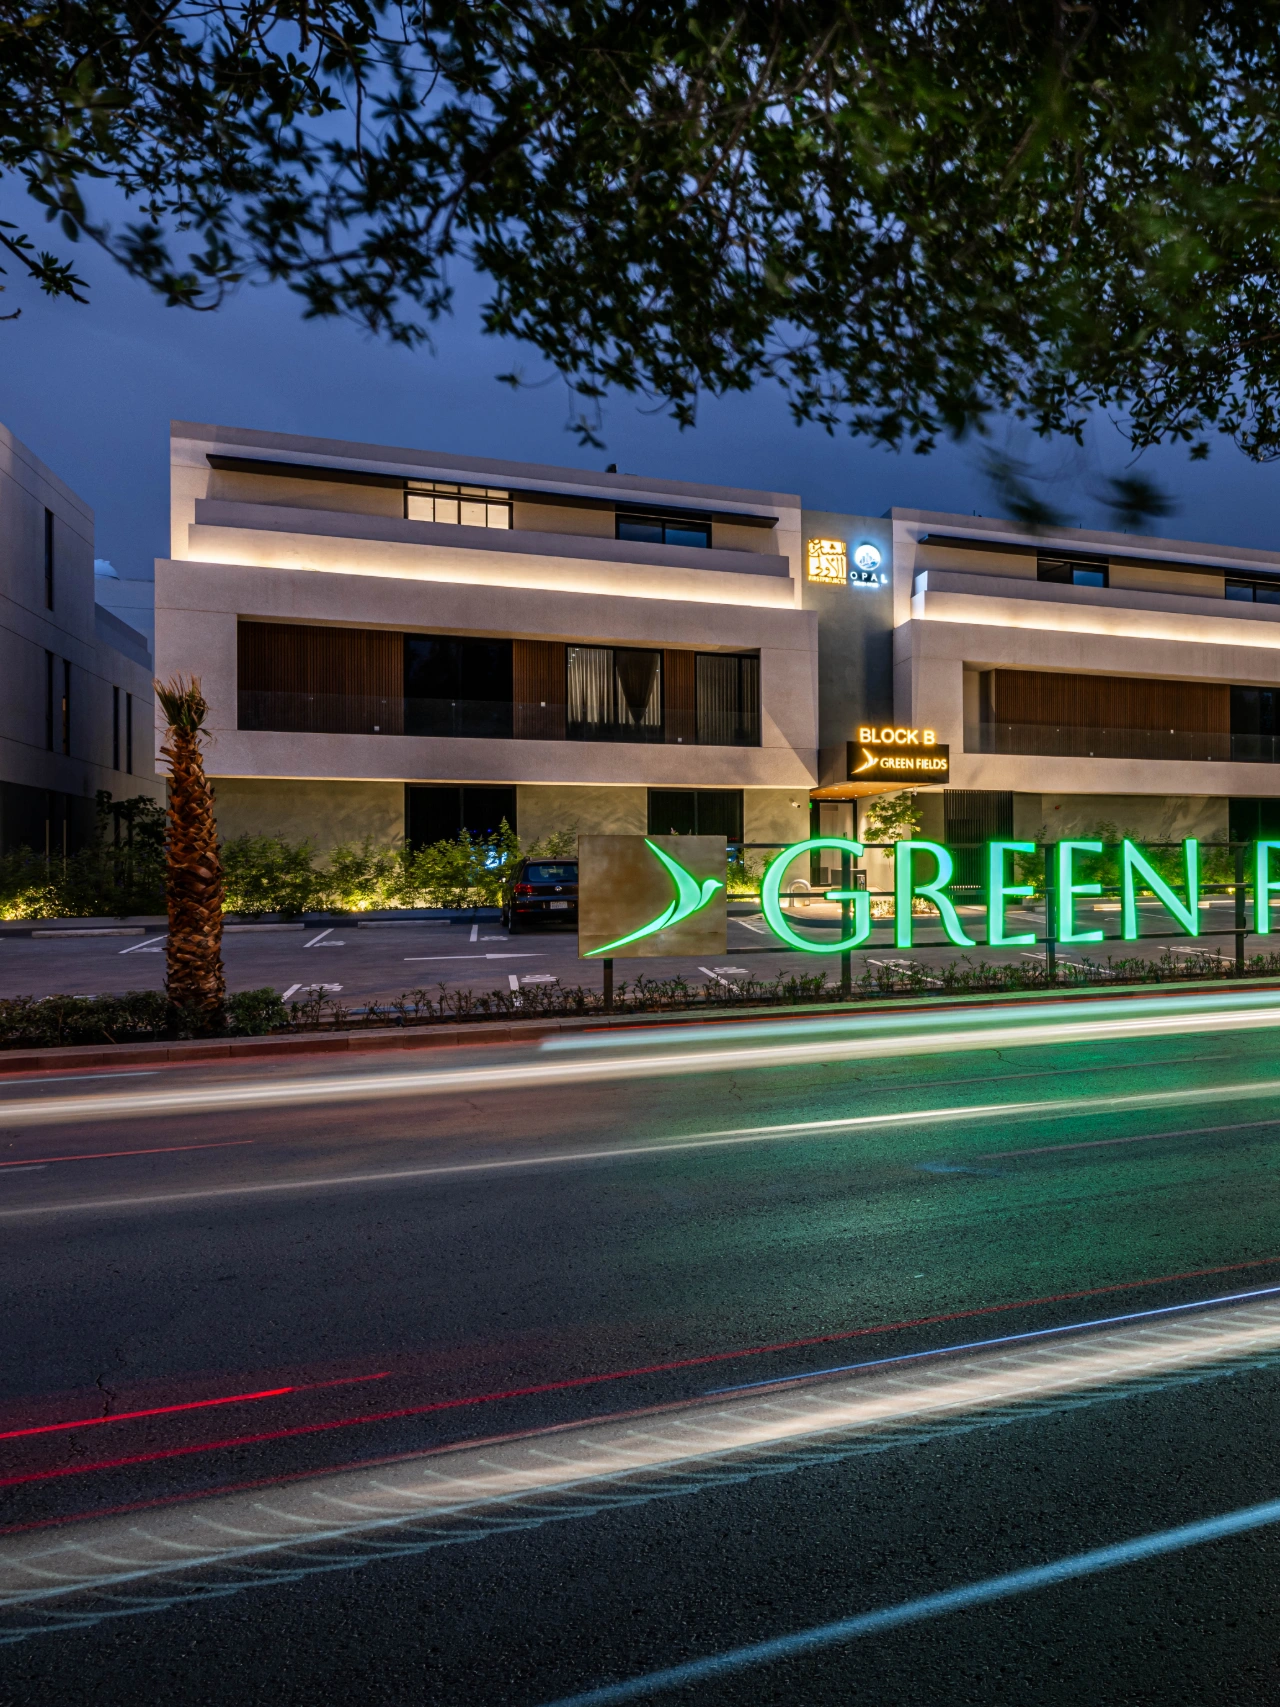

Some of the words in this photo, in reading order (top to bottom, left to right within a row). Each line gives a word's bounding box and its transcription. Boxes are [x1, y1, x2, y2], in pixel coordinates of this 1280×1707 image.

[850, 571, 888, 584] OPAL
[860, 728, 919, 744] BLOCK
[923, 730, 935, 745] B
[880, 757, 914, 769] GREEN
[915, 758, 948, 770] FIELDS
[760, 837, 1200, 954] GREEN
